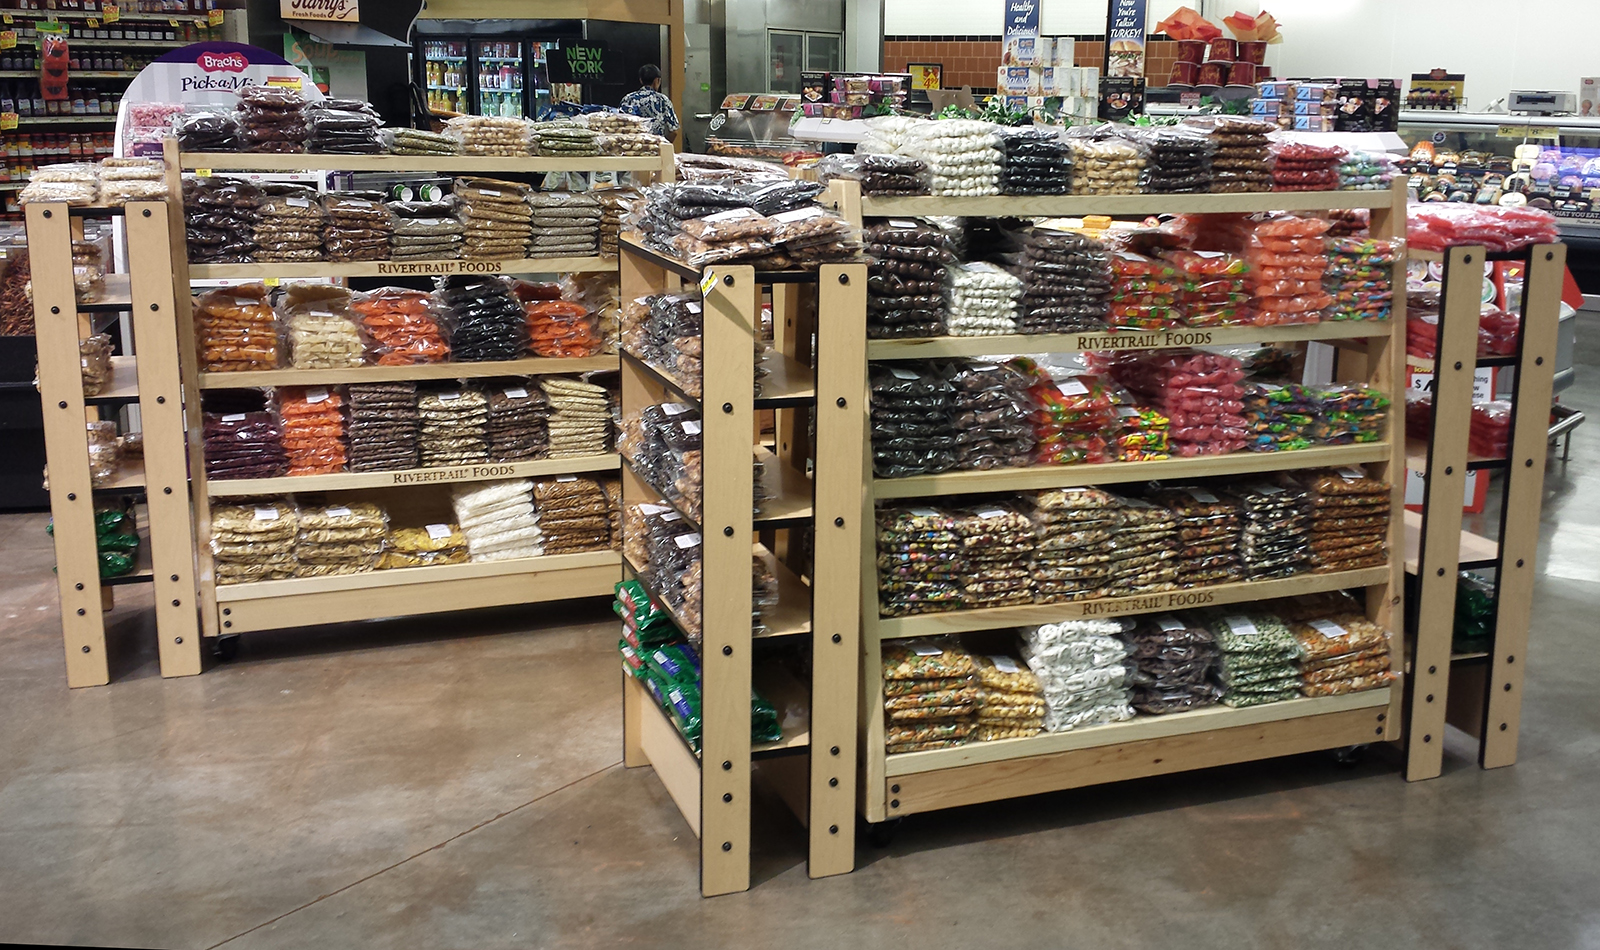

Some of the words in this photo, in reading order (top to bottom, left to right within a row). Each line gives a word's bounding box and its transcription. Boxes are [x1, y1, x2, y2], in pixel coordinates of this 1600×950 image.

[1010, 0, 1035, 15] Healthy
[1014, 13, 1029, 23] and
[1007, 25, 1037, 35] Delicious!
[1111, 28, 1142, 38] TURKEY!
[566, 44, 602, 60] NEW
[568, 60, 604, 73] YORK
[459, 262, 501, 272] FOODS
[1165, 332, 1212, 346] FOODS
[473, 466, 515, 477] FOODS
[1168, 592, 1214, 606] FOODS
